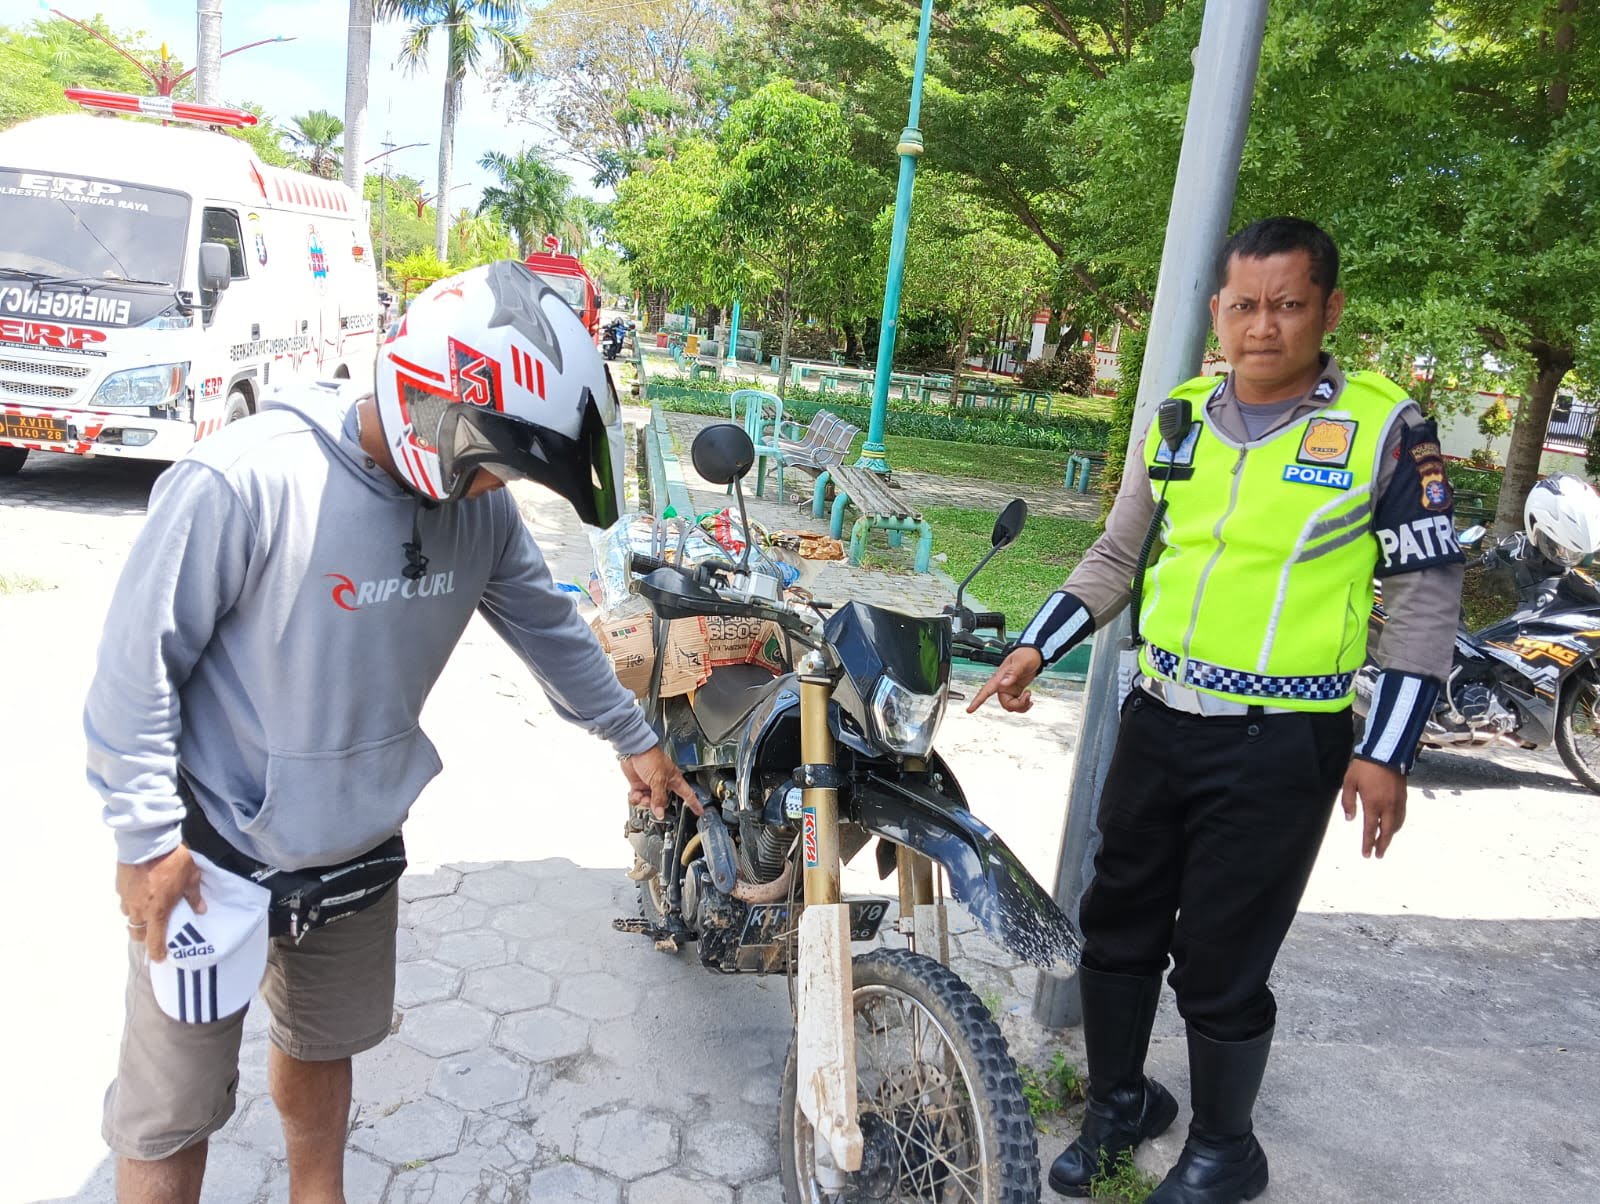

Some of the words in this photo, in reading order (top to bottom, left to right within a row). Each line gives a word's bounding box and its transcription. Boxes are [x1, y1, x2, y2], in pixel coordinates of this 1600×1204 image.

[19, 173, 122, 197] ERP
[50, 191, 115, 207] PALANGKA
[117, 199, 150, 212] RAYA
[0, 318, 107, 349] ERP
[19, 417, 55, 428] XVIII
[1285, 466, 1350, 487] POLRI
[1375, 515, 1460, 568] PATR
[356, 578, 400, 605] RIP
[401, 571, 455, 599] CURL
[173, 944, 216, 960] didas
